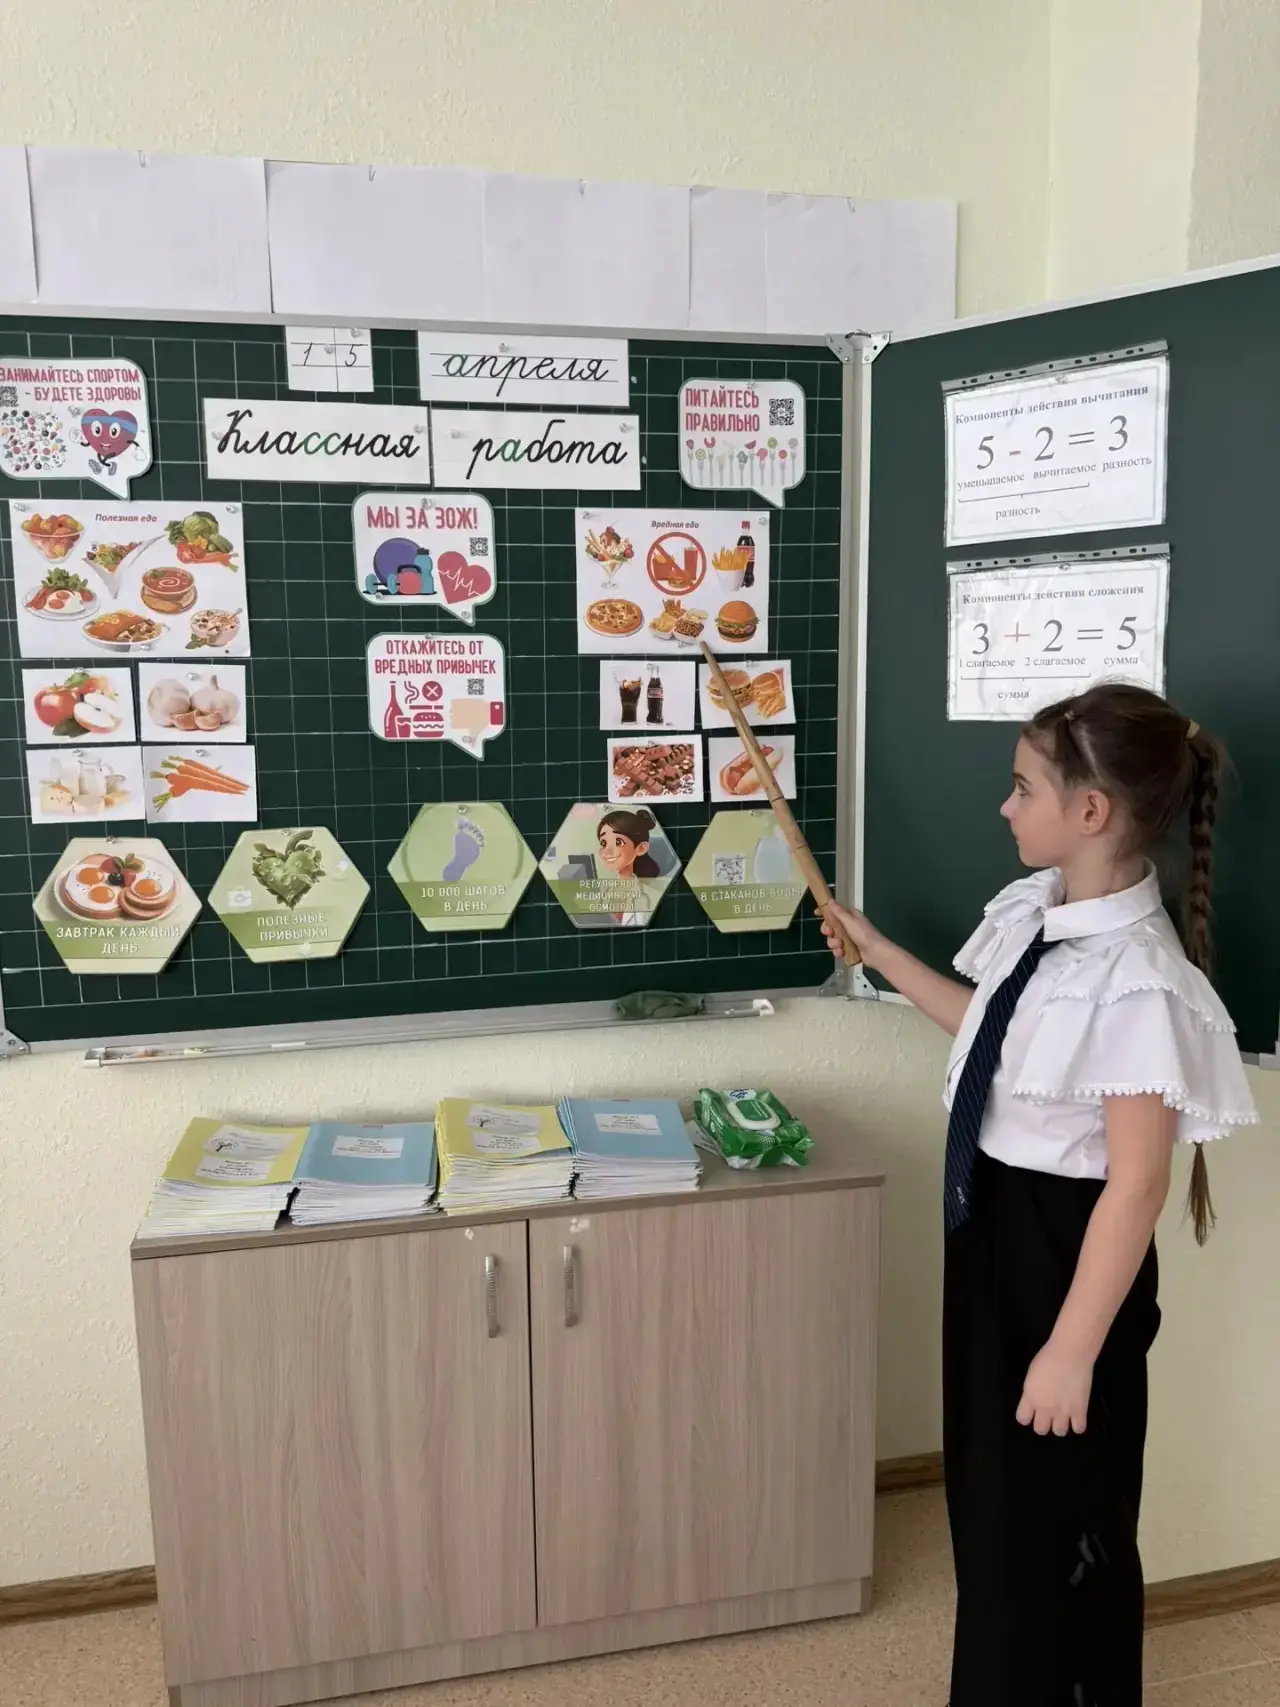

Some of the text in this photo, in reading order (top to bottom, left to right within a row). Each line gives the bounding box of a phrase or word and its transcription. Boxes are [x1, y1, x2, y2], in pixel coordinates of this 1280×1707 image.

[0, 365, 140, 384] ЗАНИМАЙТЕСЬ СПОРТОМ
[442, 354, 609, 397] апреля
[34, 386, 83, 402] БУДЕТЕ
[87, 386, 142, 402] ЗДОРОВЫ
[685, 385, 760, 408] ПИТАЙТЕСЬ
[955, 406, 1024, 425] Компоненты
[1081, 386, 1149, 404] вычитания
[685, 412, 760, 432] ПРАВИЛЬНО
[217, 409, 628, 480] Классная работа
[976, 434, 995, 470] 5
[1034, 426, 1055, 462] 2
[1108, 415, 1129, 451] 3
[957, 456, 1152, 491] уменьшаемое вычитаемое разность
[95, 513, 158, 523] Полезная еда
[366, 505, 478, 530] МЫ ЗА ЗОЖ!
[995, 505, 1041, 520] разность
[651, 520, 699, 529] Вредная еда
[972, 622, 990, 655] 3
[1042, 619, 1064, 652] 2
[1116, 616, 1137, 650] 5
[385, 639, 483, 656] ОТКАЖИТЕСЬ ОТ
[375, 659, 496, 676] ВРЕДНЫХ ПРИВЫЧЕК
[966, 658, 1016, 668] слагаемое
[1024, 657, 1031, 666] 2
[1033, 657, 1086, 666] слагаемое
[1104, 655, 1139, 666] сумма
[998, 690, 1030, 700] сумма
[420, 885, 506, 898] 10 000 ШАГОВ
[711, 888, 766, 901] СТАКАНОВ
[444, 901, 488, 912] В ДЕНЬ
[734, 904, 741, 914] В
[257, 912, 327, 927] ПОЛЕЗНЫЕ
[56, 924, 181, 939] ЗАВТРАК КАЖДЫЙ
[260, 927, 329, 942] ПРИВЫЧКИ
[101, 943, 139, 955] ДЕНЬ
